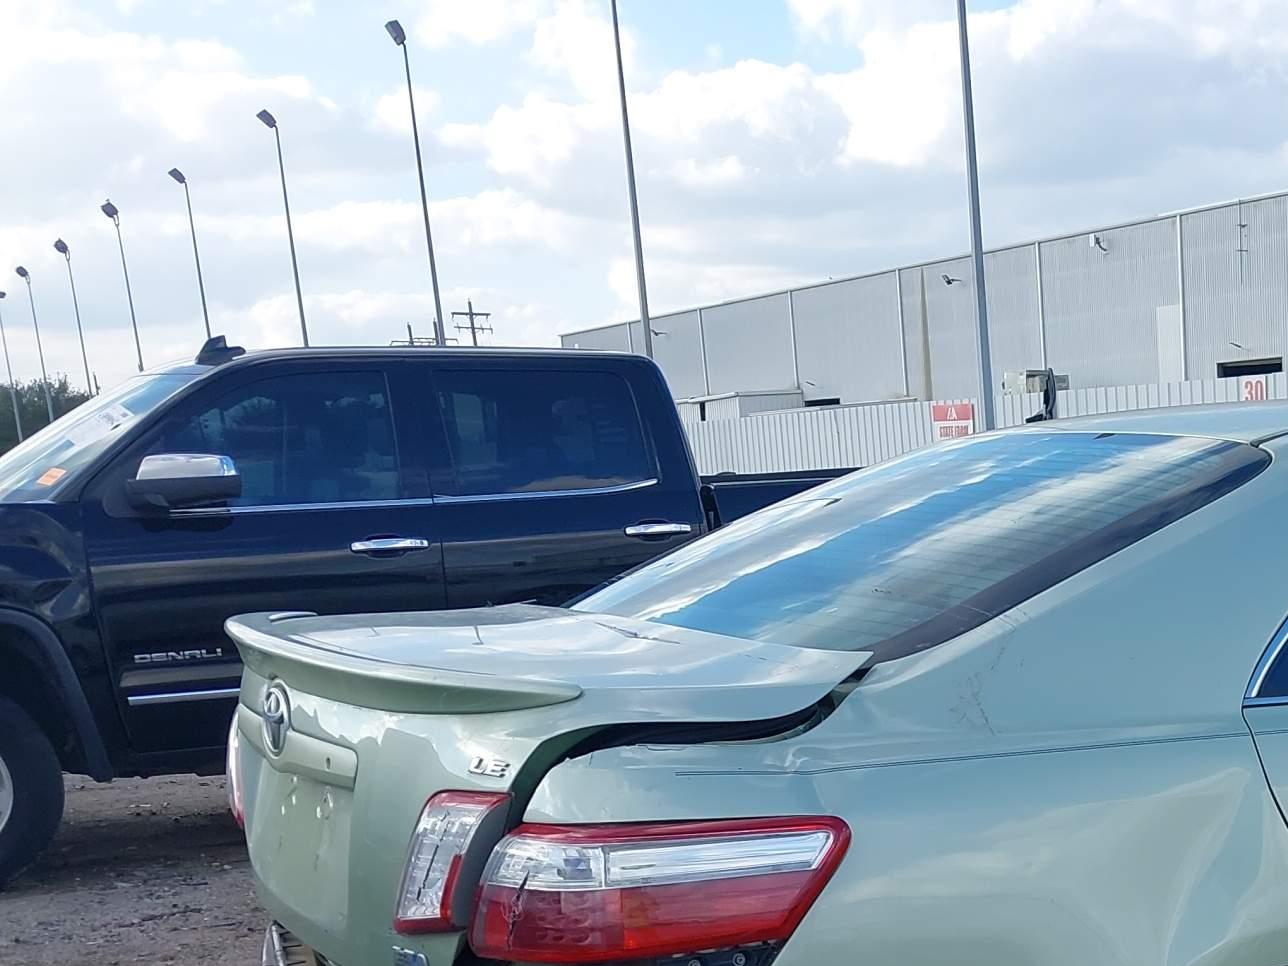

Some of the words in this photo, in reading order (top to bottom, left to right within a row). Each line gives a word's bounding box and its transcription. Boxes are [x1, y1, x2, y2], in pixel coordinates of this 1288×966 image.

[1244, 380, 1265, 401] 30
[133, 647, 223, 663] DENALI
[468, 756, 511, 778] LE
